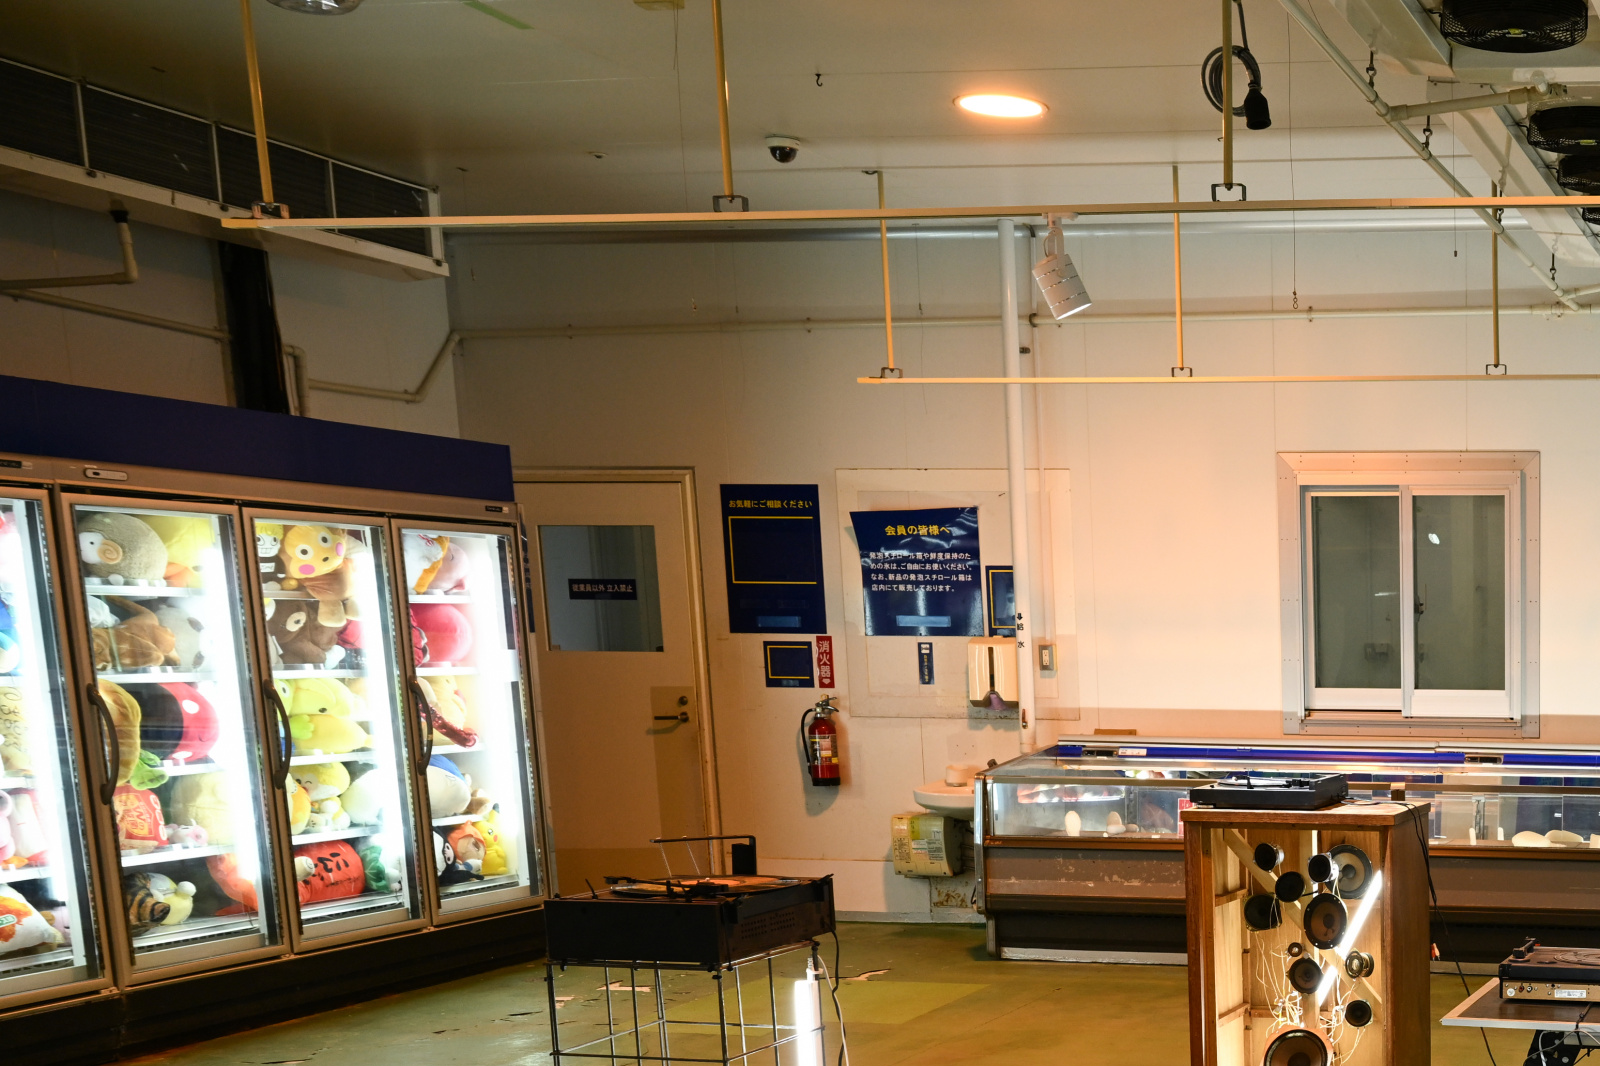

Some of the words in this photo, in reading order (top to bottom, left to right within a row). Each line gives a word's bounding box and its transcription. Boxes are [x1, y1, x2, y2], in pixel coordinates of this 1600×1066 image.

[728, 500, 813, 508] お気軽にご相談ください
[884, 525, 951, 536] 会員の皆様へ
[869, 552, 971, 560] 発泡スチロール箱や鮮度保持のた
[870, 563, 973, 571] めの氷は、ご自由にお使いください。
[870, 573, 973, 582] なお、新品の発泡スチロール箱は
[606, 584, 633, 592] 立入禁止
[871, 584, 956, 592] 店内にて販売しております。
[818, 640, 831, 678] 消火器
